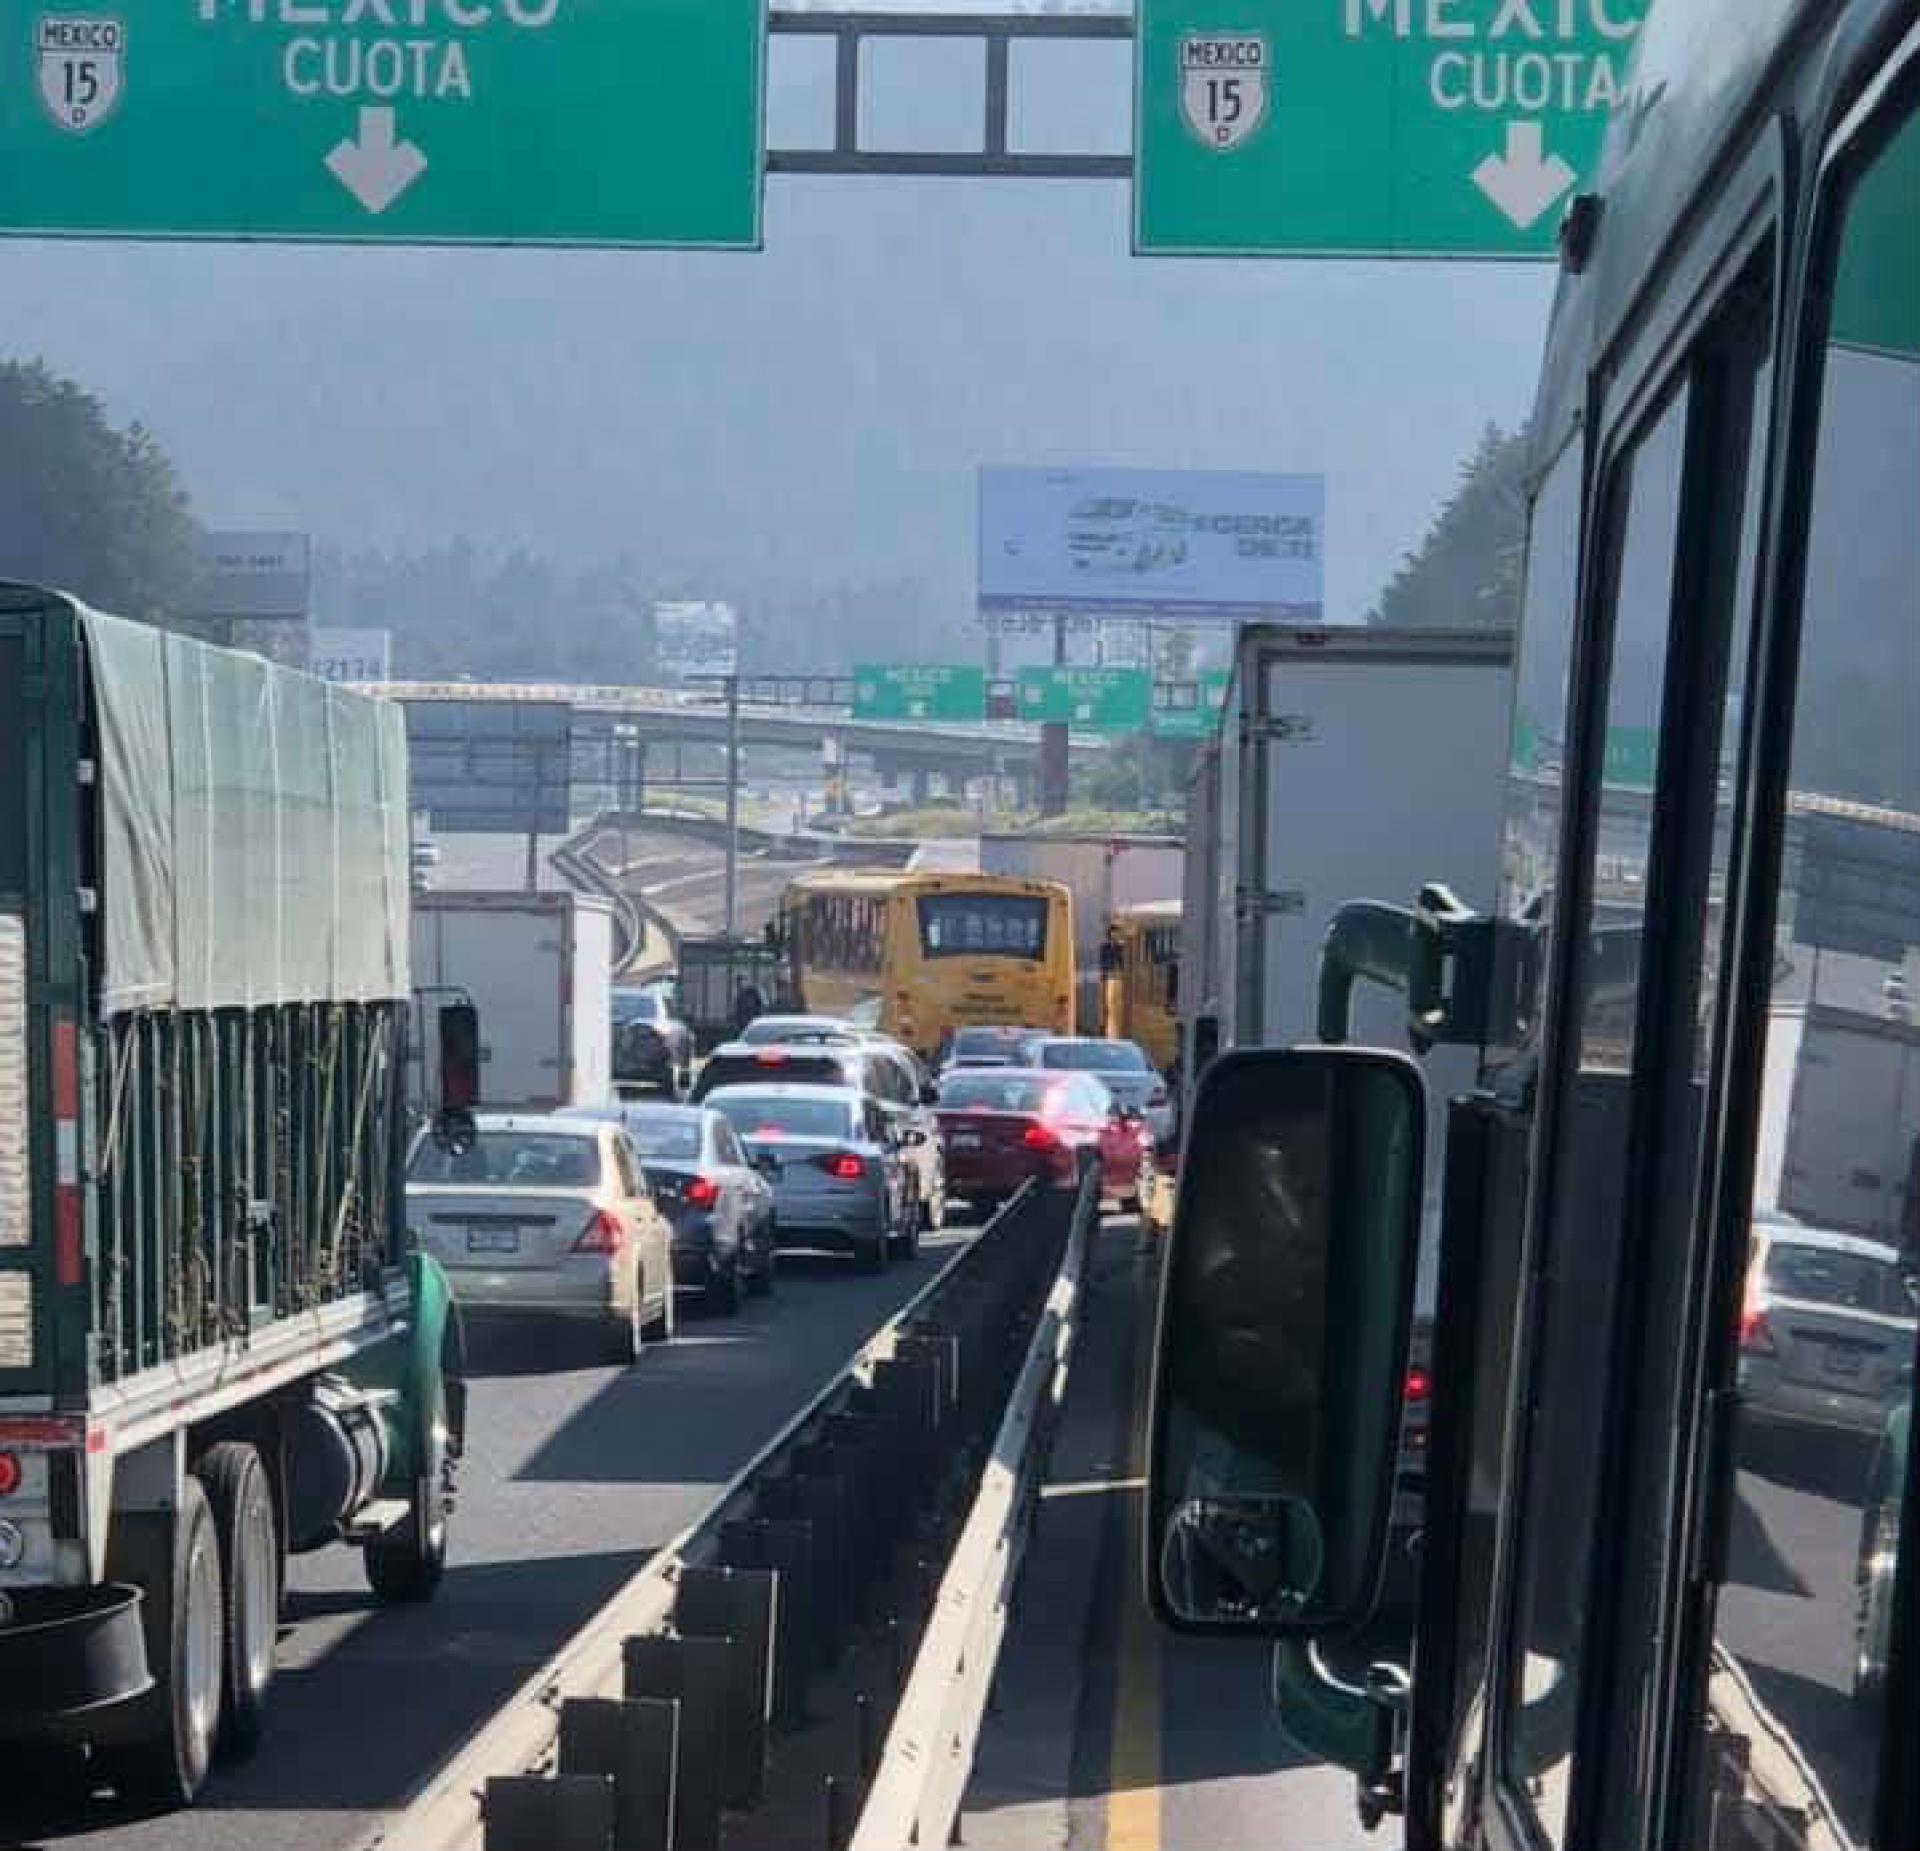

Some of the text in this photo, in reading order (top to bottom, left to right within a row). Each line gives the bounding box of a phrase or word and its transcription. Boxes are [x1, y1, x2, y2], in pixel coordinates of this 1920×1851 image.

[45, 23, 116, 47] MEXICO
[1187, 42, 1261, 65] MEXICO
[63, 60, 97, 105] 15
[284, 37, 472, 97] CUOTA
[1431, 51, 1622, 111] CUOTA
[1206, 79, 1241, 124] 15
